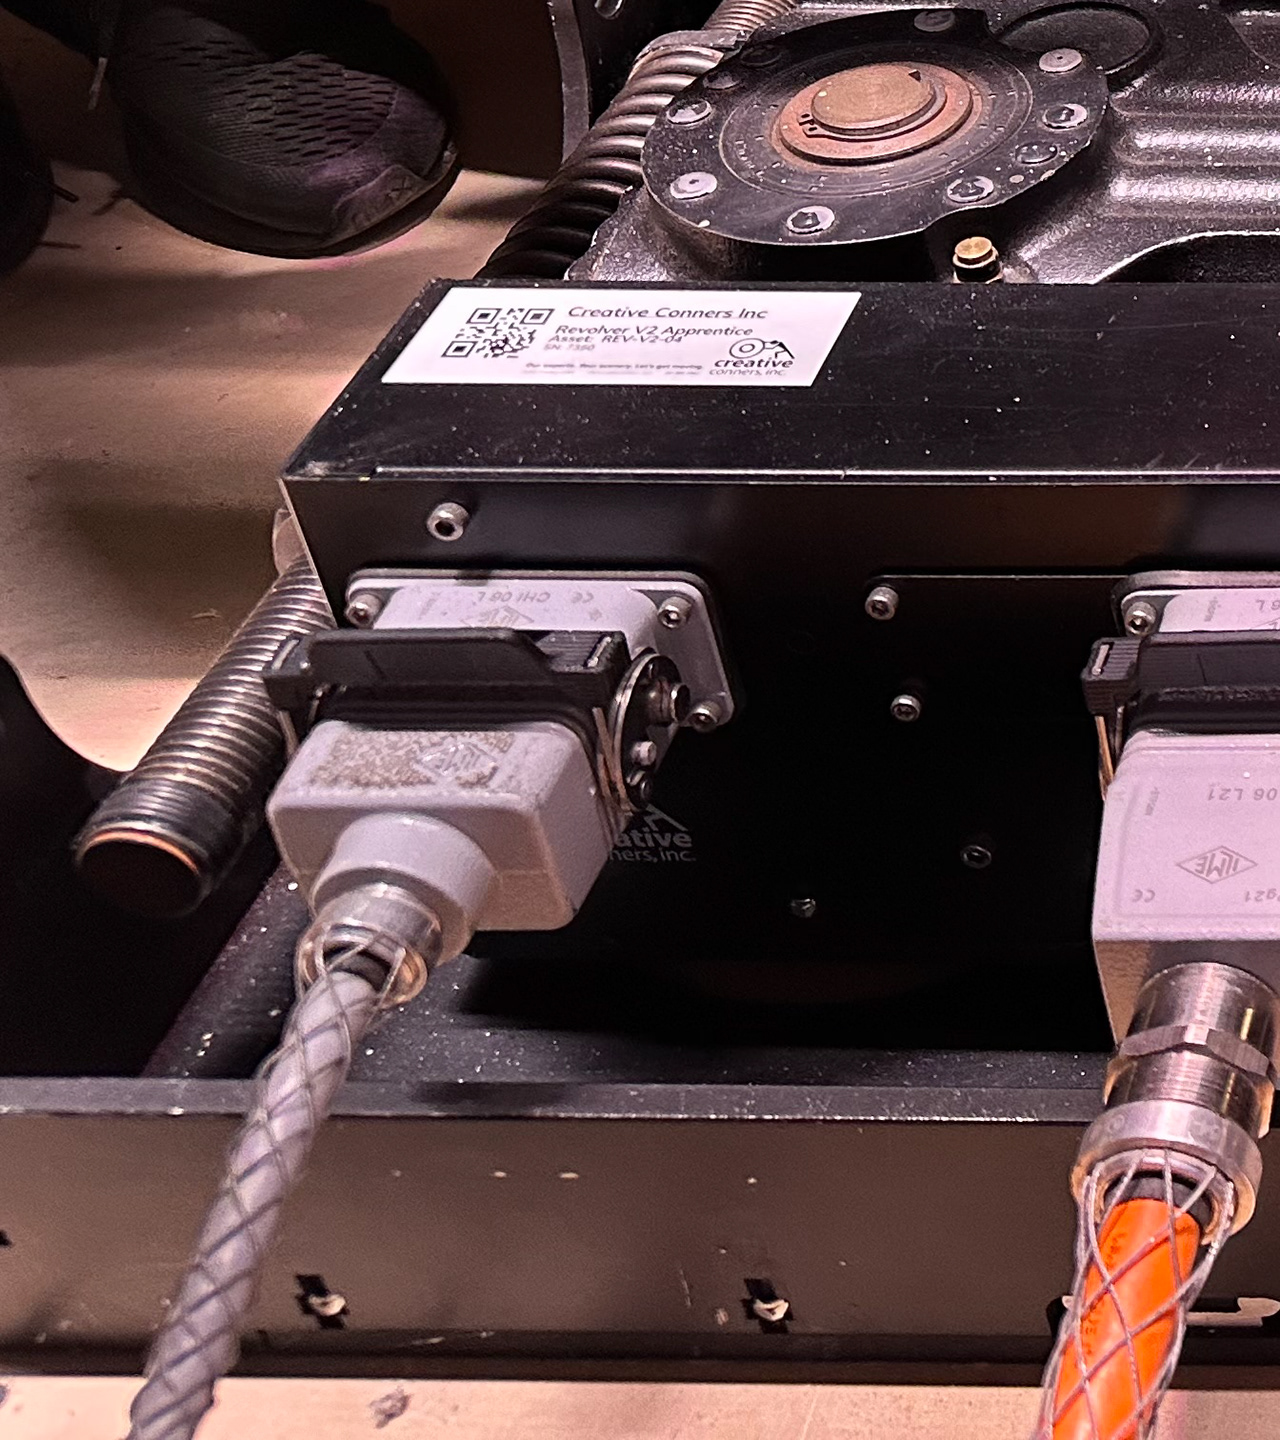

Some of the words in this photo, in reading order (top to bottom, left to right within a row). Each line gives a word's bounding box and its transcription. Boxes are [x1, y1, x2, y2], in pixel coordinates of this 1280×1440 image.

[568, 306, 649, 319] Creative
[655, 307, 732, 319] Conners
[738, 308, 768, 319] Inc
[555, 325, 630, 335] Revolver
[636, 325, 658, 335] V2
[661, 325, 753, 338] Apprentice
[714, 357, 794, 368] creative
[1256, 599, 1265, 611] L
[1207, 787, 1243, 801] L21
[1253, 787, 1277, 801] 06
[613, 826, 693, 848] ative
